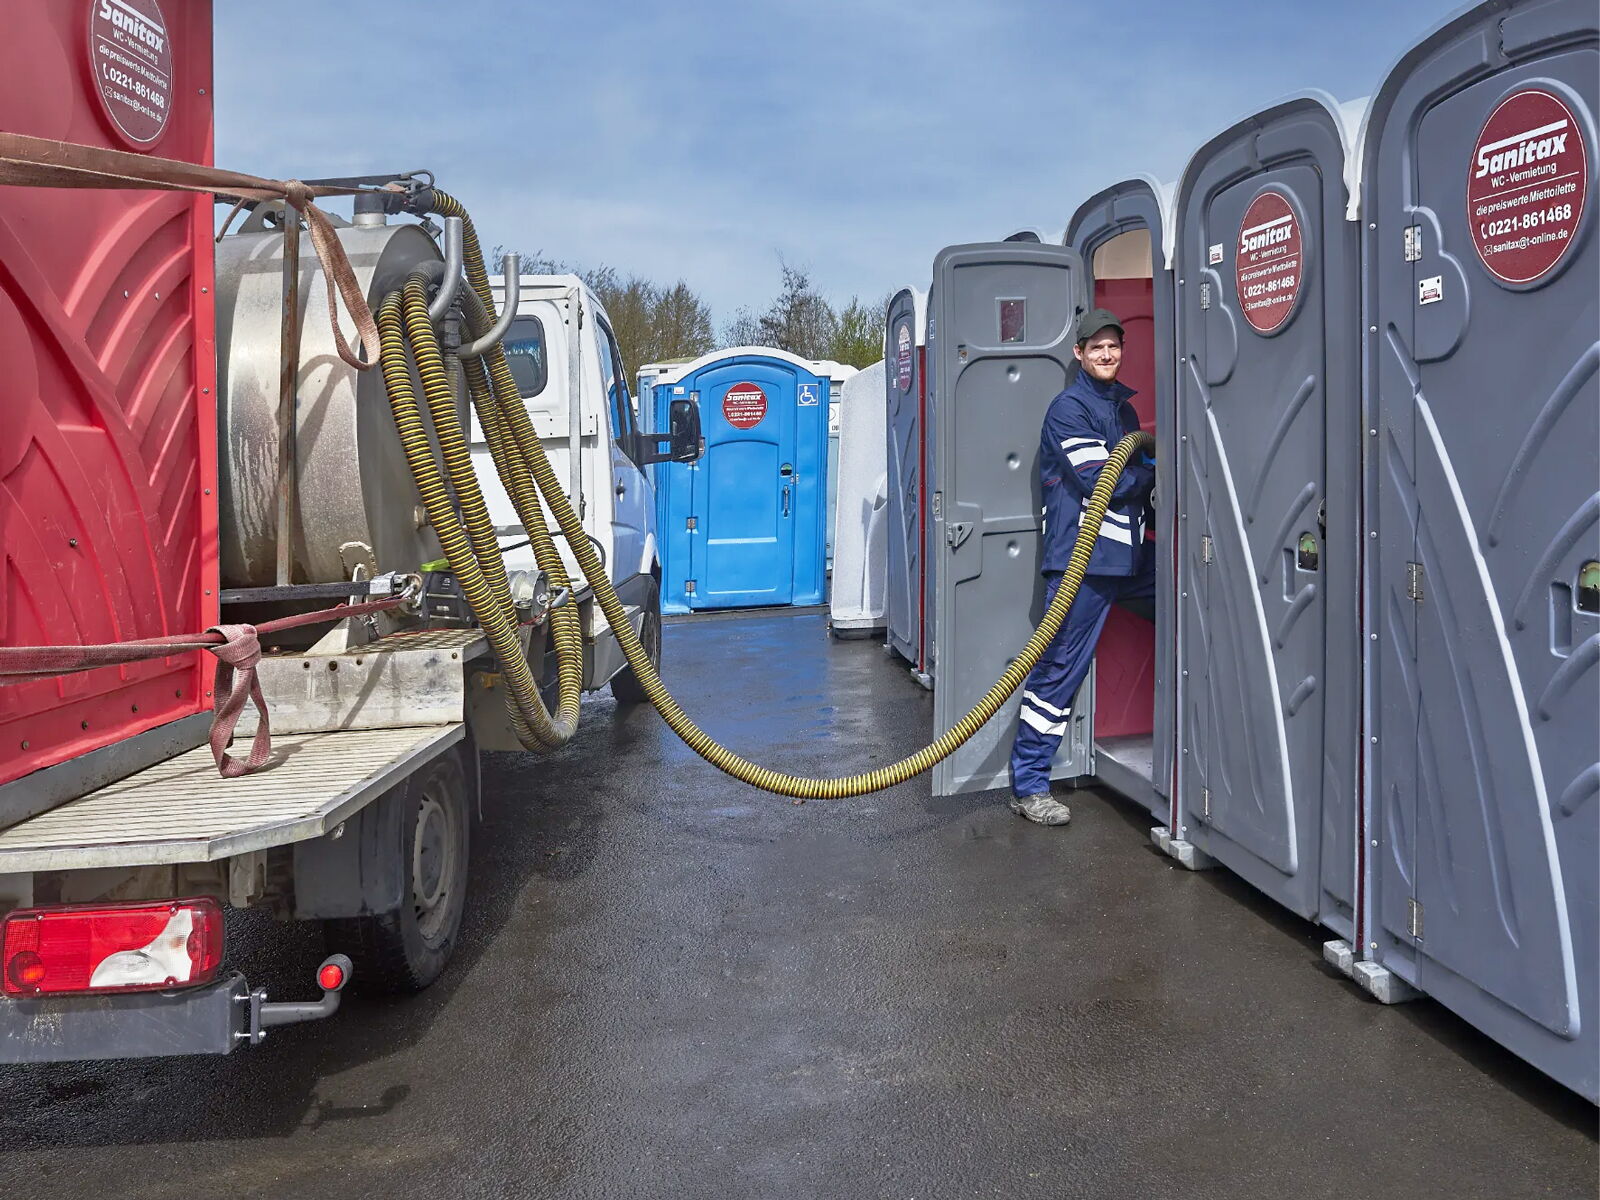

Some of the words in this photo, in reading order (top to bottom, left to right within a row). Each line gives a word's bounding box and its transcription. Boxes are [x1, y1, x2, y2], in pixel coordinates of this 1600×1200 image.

[100, 0, 164, 53] Sanitax
[99, 44, 110, 56] die
[109, 67, 164, 108] 0221-861468
[1476, 119, 1568, 178] Sanitax
[1476, 204, 1488, 216] die
[1488, 194, 1529, 215] preiswerte
[1529, 183, 1576, 202] Miettoilette
[1241, 214, 1293, 254] Sanitax
[1489, 204, 1572, 237] 0221-861468
[1493, 229, 1568, 253] sanitax@t-online.de
[1248, 275, 1295, 297] 0221-861468
[726, 391, 762, 401] Sanitax
